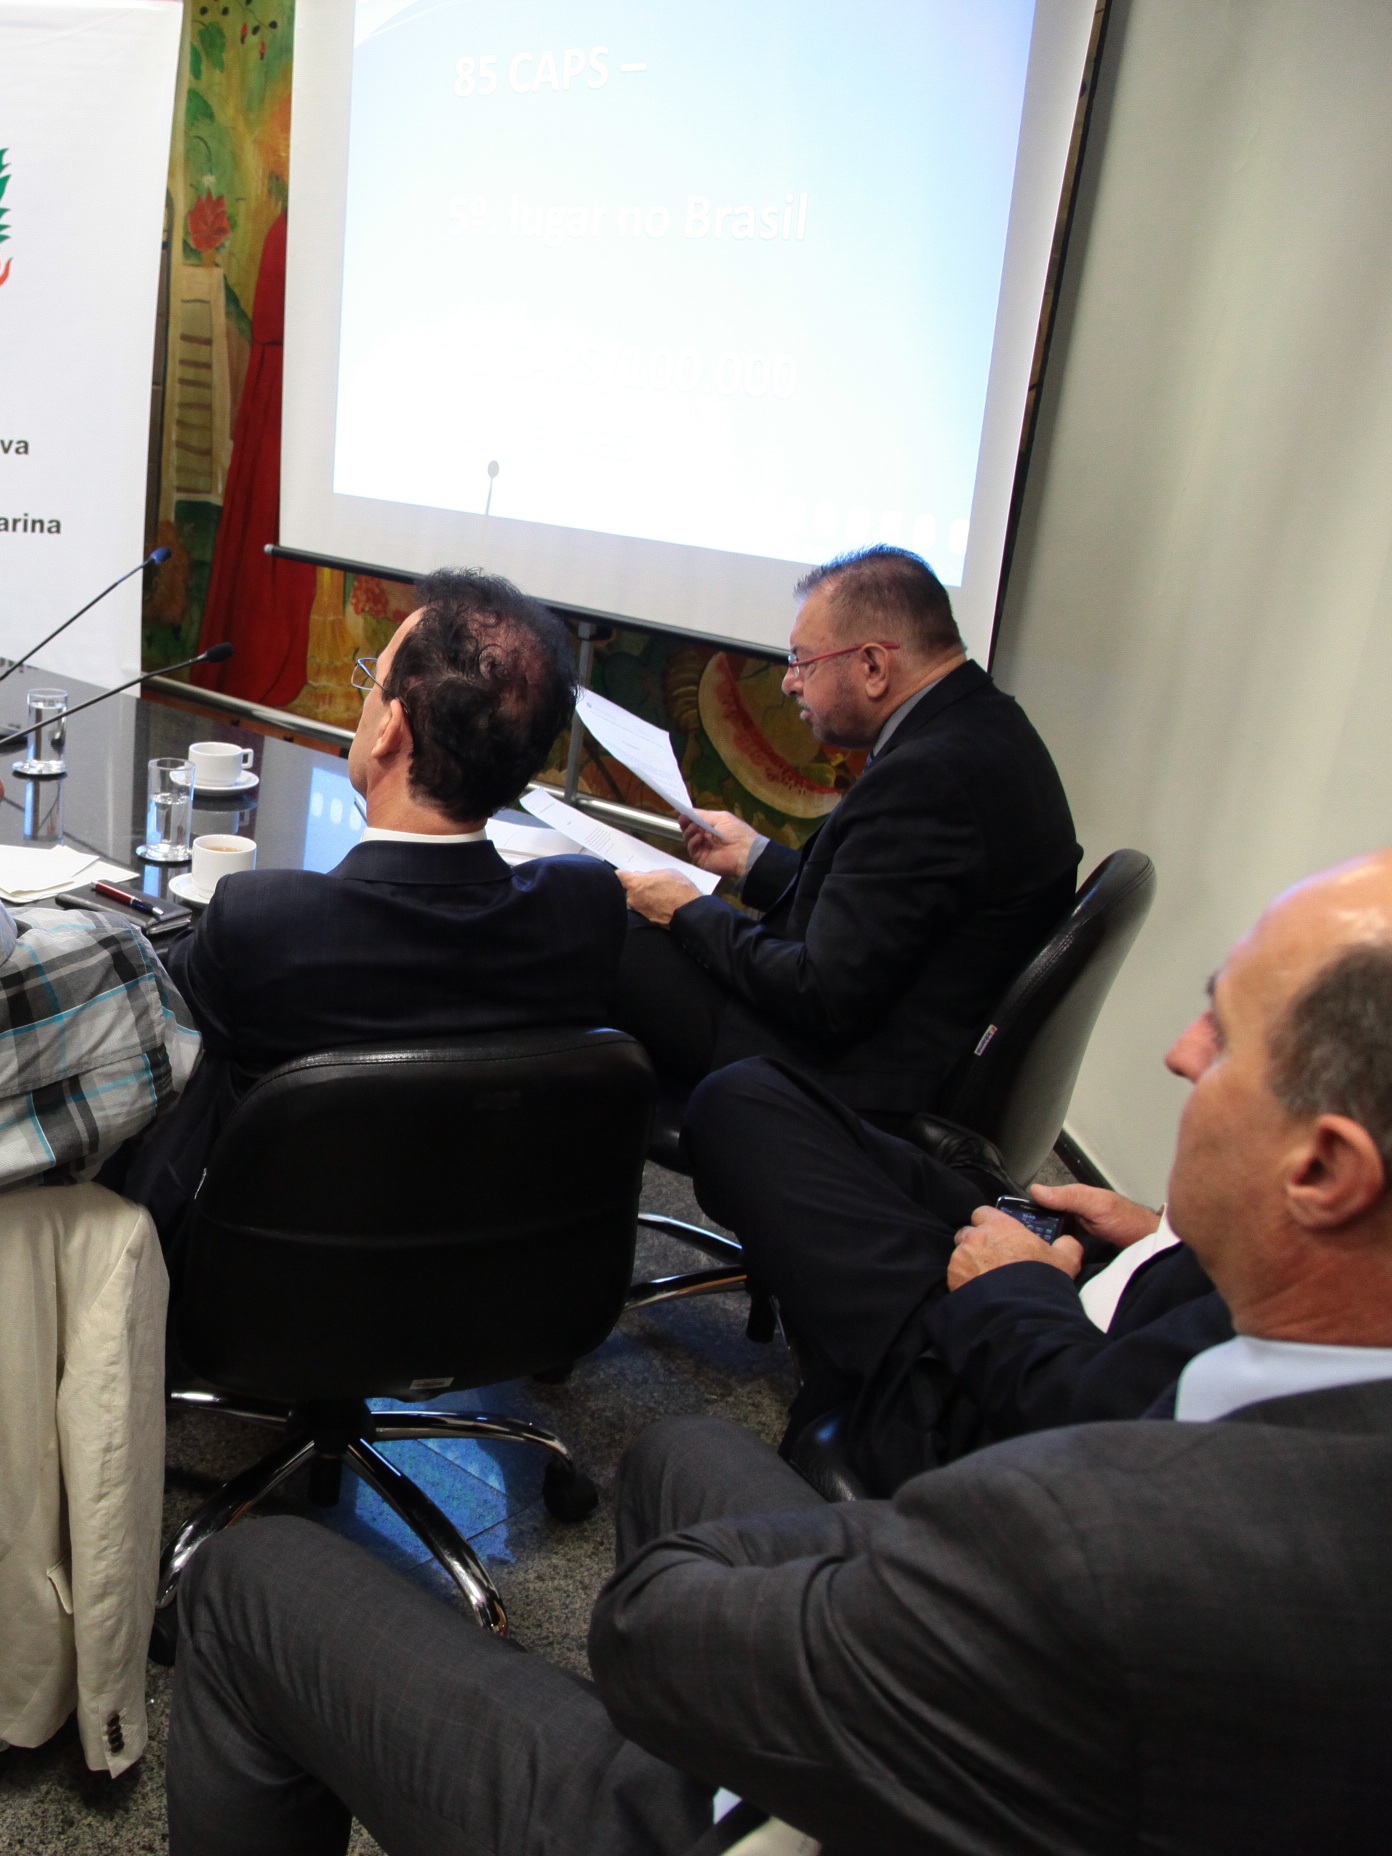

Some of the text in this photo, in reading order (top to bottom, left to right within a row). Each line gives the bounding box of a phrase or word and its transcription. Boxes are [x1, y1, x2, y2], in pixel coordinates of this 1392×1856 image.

[453, 54, 499, 97] 85
[509, 44, 609, 93] CAPS
[509, 192, 609, 248] lugar
[617, 204, 671, 241] no
[684, 191, 809, 241] Brasil
